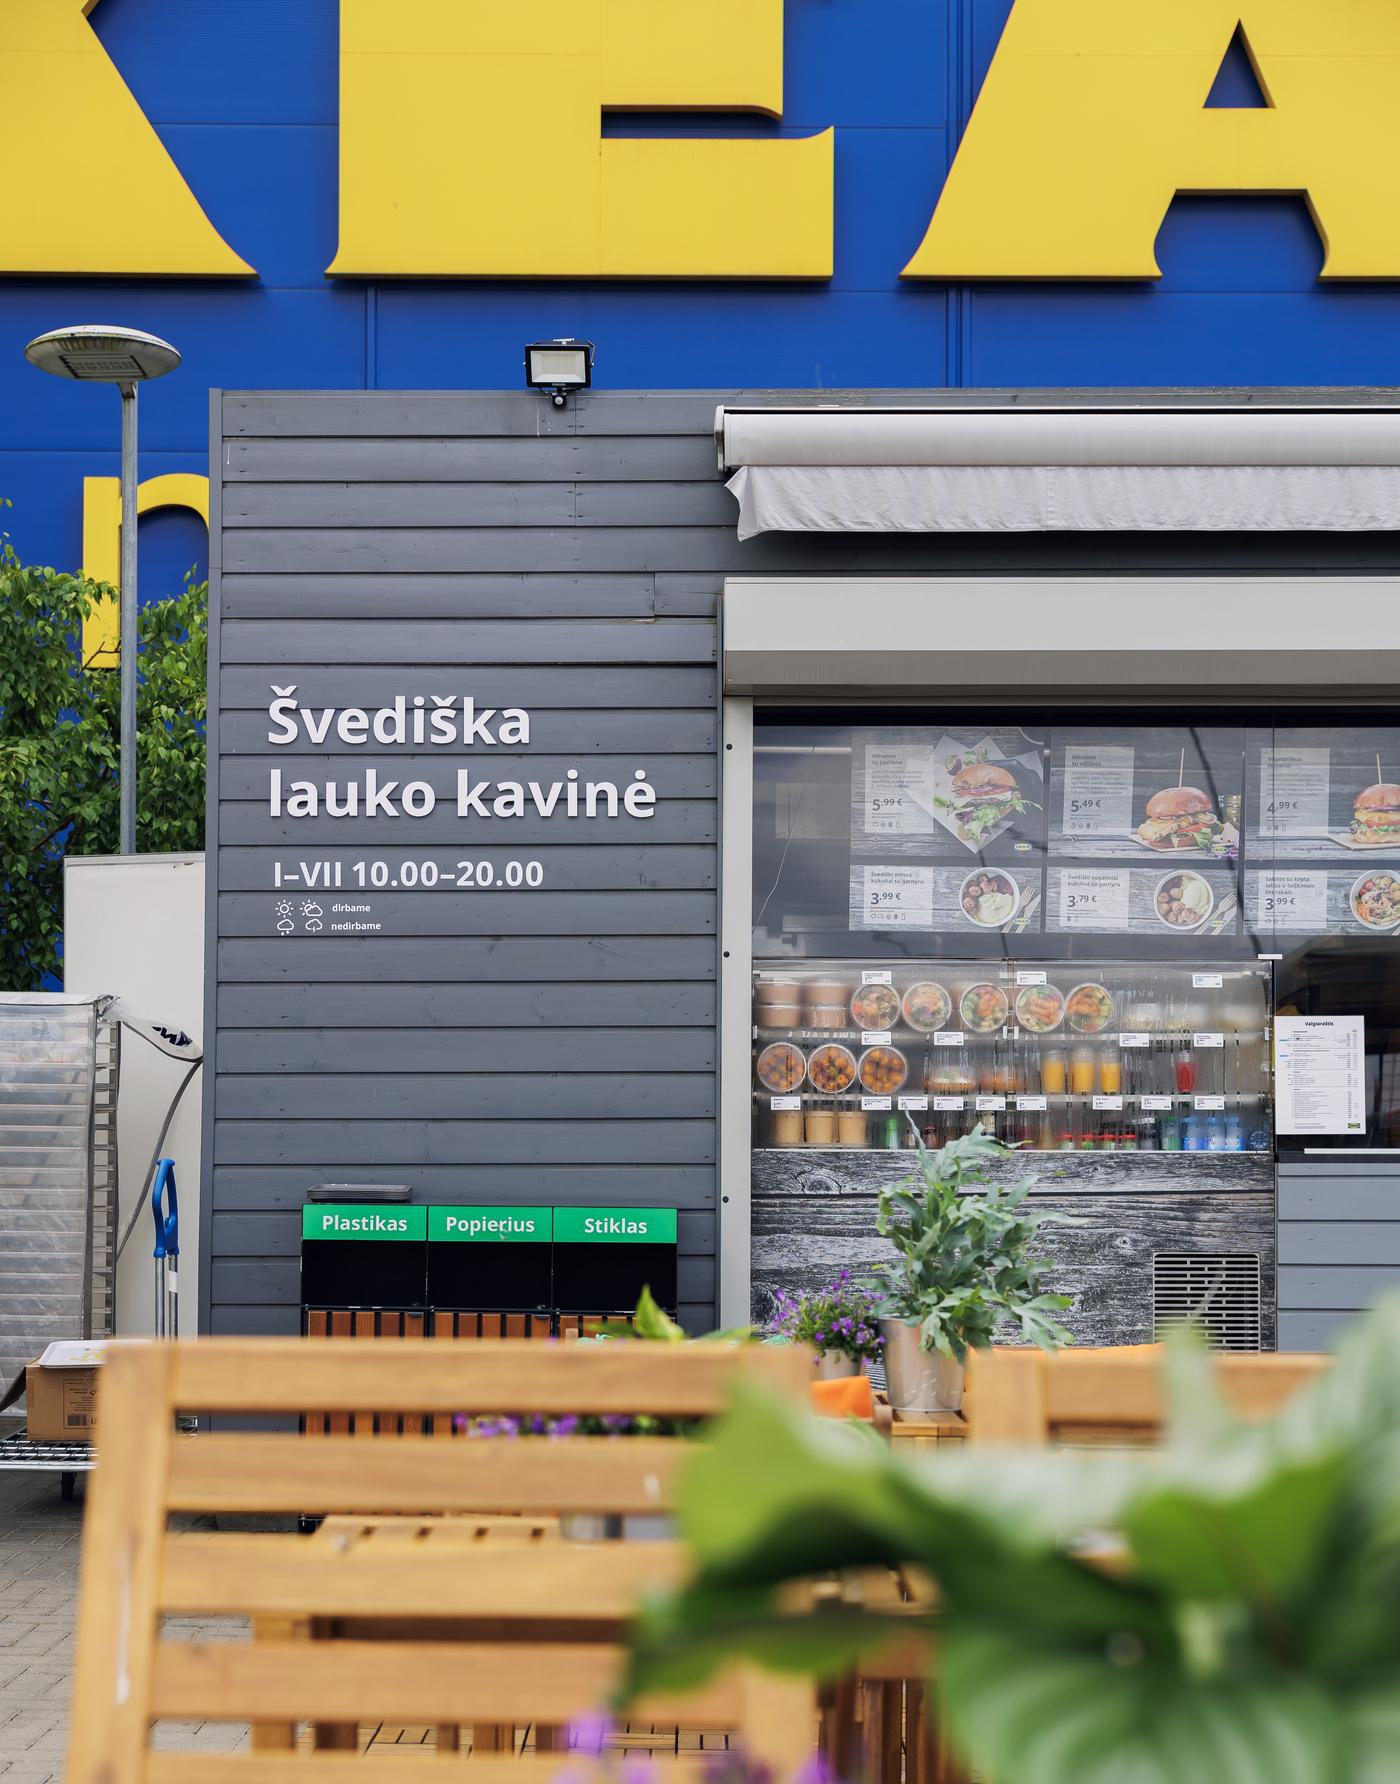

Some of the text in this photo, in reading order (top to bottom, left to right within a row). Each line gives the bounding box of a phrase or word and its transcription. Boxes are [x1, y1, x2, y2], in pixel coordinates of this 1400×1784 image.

[268, 685, 530, 745] Švediška
[270, 768, 657, 818] lauko kavinė
[897, 798, 903, 807] €
[1095, 799, 1102, 808] €
[1292, 801, 1298, 809] €
[895, 892, 901, 901] €
[1091, 895, 1097, 903] €
[1290, 897, 1296, 905] €
[331, 903, 371, 913] dirbame
[331, 921, 382, 931] nedirbame
[322, 1214, 408, 1232] Plastikas
[446, 1216, 535, 1236] Popierius
[584, 1217, 648, 1234] Stiklas
